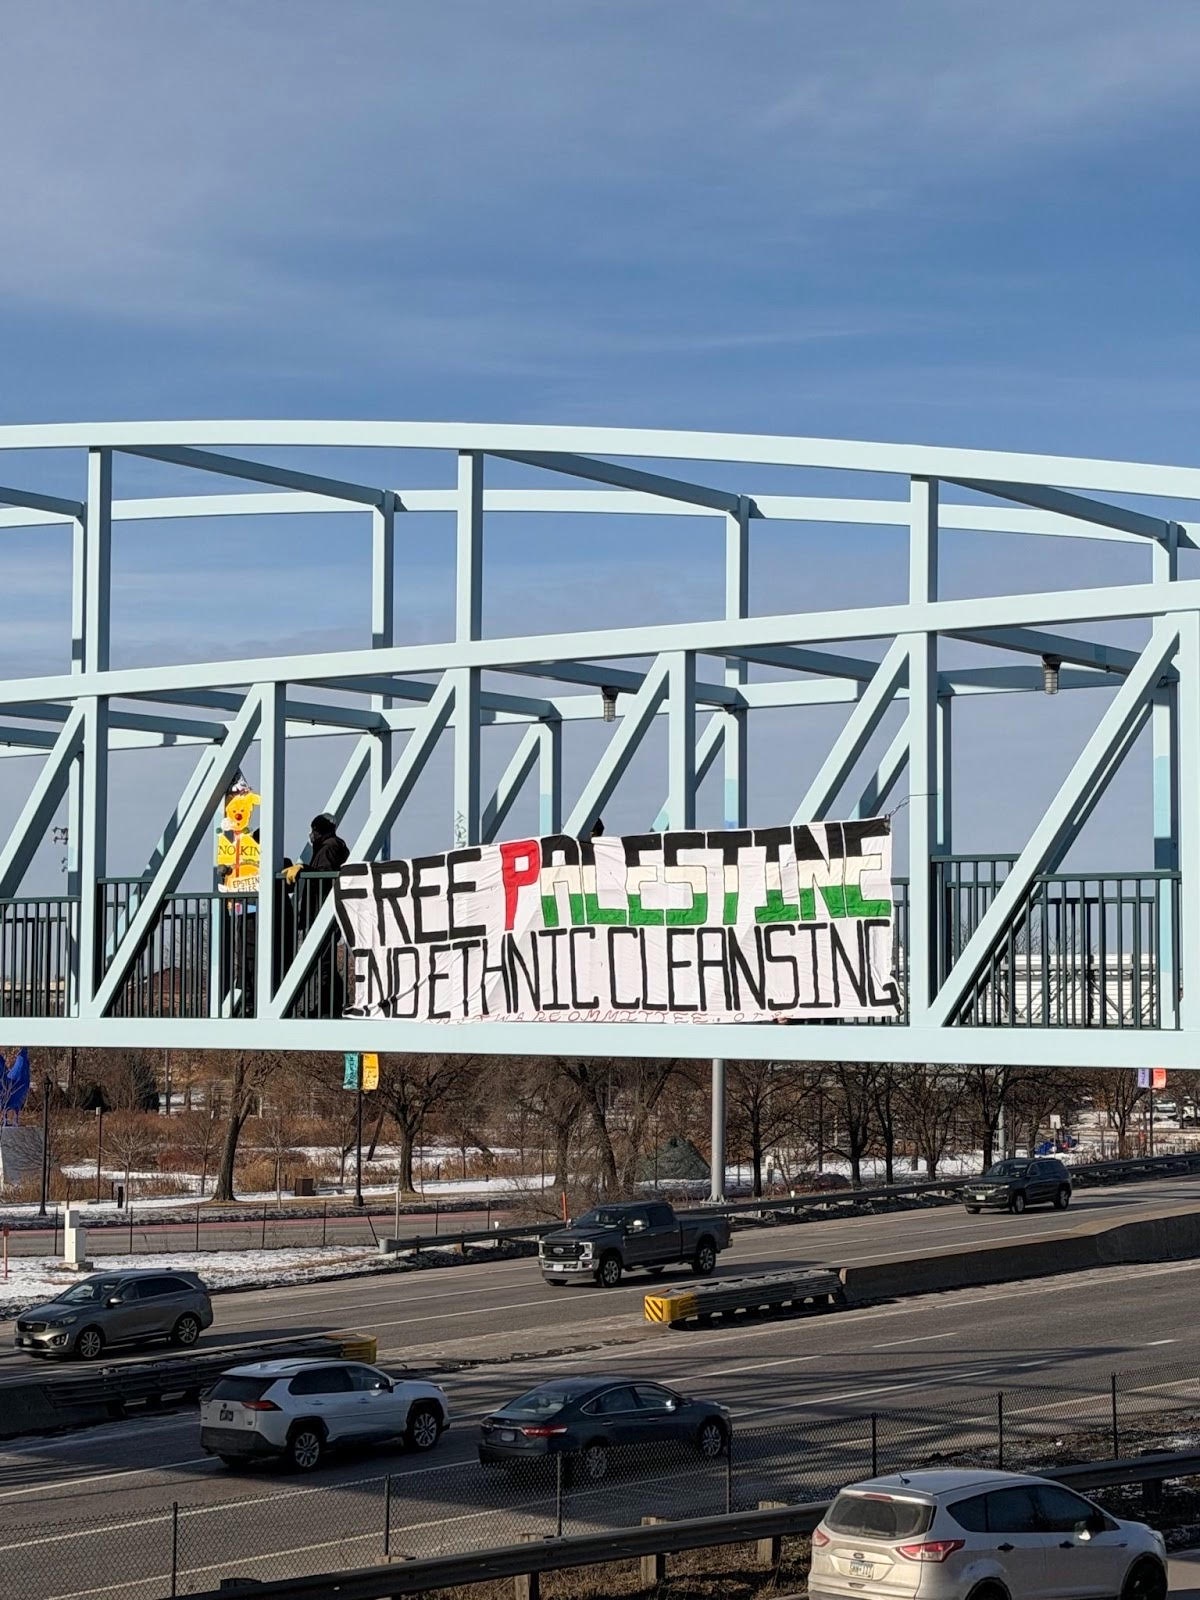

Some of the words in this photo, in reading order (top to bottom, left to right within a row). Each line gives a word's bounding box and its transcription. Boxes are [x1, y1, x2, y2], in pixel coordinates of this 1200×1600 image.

[218, 846, 236, 856] NO
[233, 877, 260, 888] EPSTEIN
[334, 848, 487, 947] FREE
[501, 818, 891, 930] PALESTINE
[343, 947, 420, 1018] END
[428, 927, 600, 1019] ETHNIC
[608, 919, 904, 1014] CLEANSING
